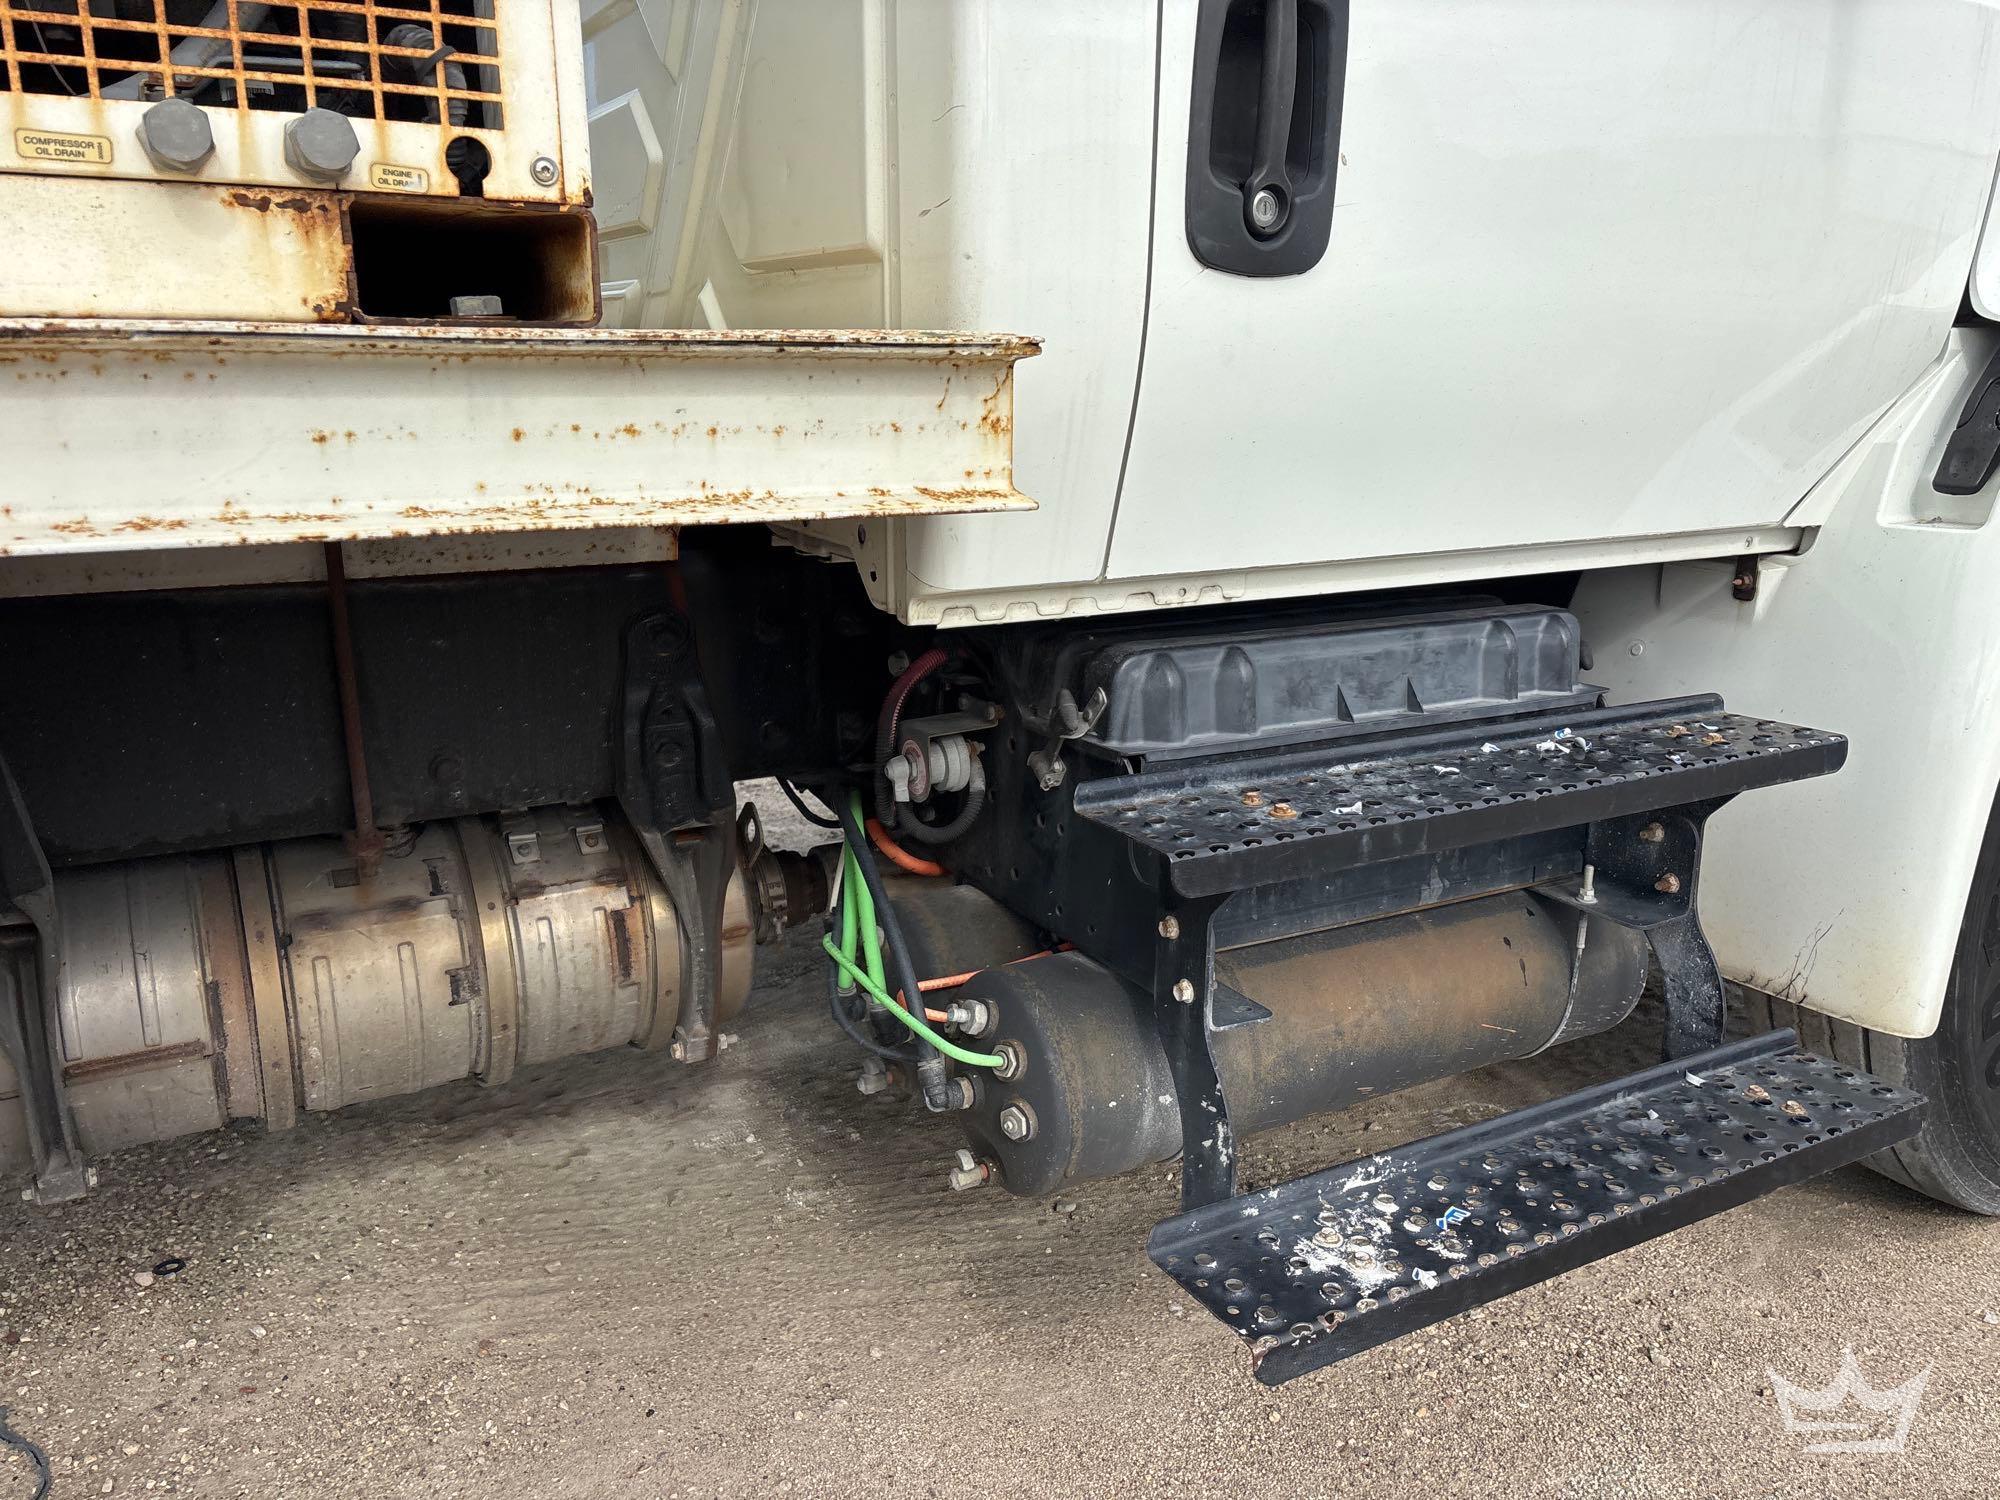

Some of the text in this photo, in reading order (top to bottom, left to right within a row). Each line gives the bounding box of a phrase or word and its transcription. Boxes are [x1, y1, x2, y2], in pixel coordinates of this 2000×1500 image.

[23, 136, 95, 149] COMPRESSOR
[35, 147, 85, 158] OIL DRAIN
[382, 168, 412, 178] ENGINE
[377, 177, 391, 186] OIL
[392, 179, 414, 188] DRA
